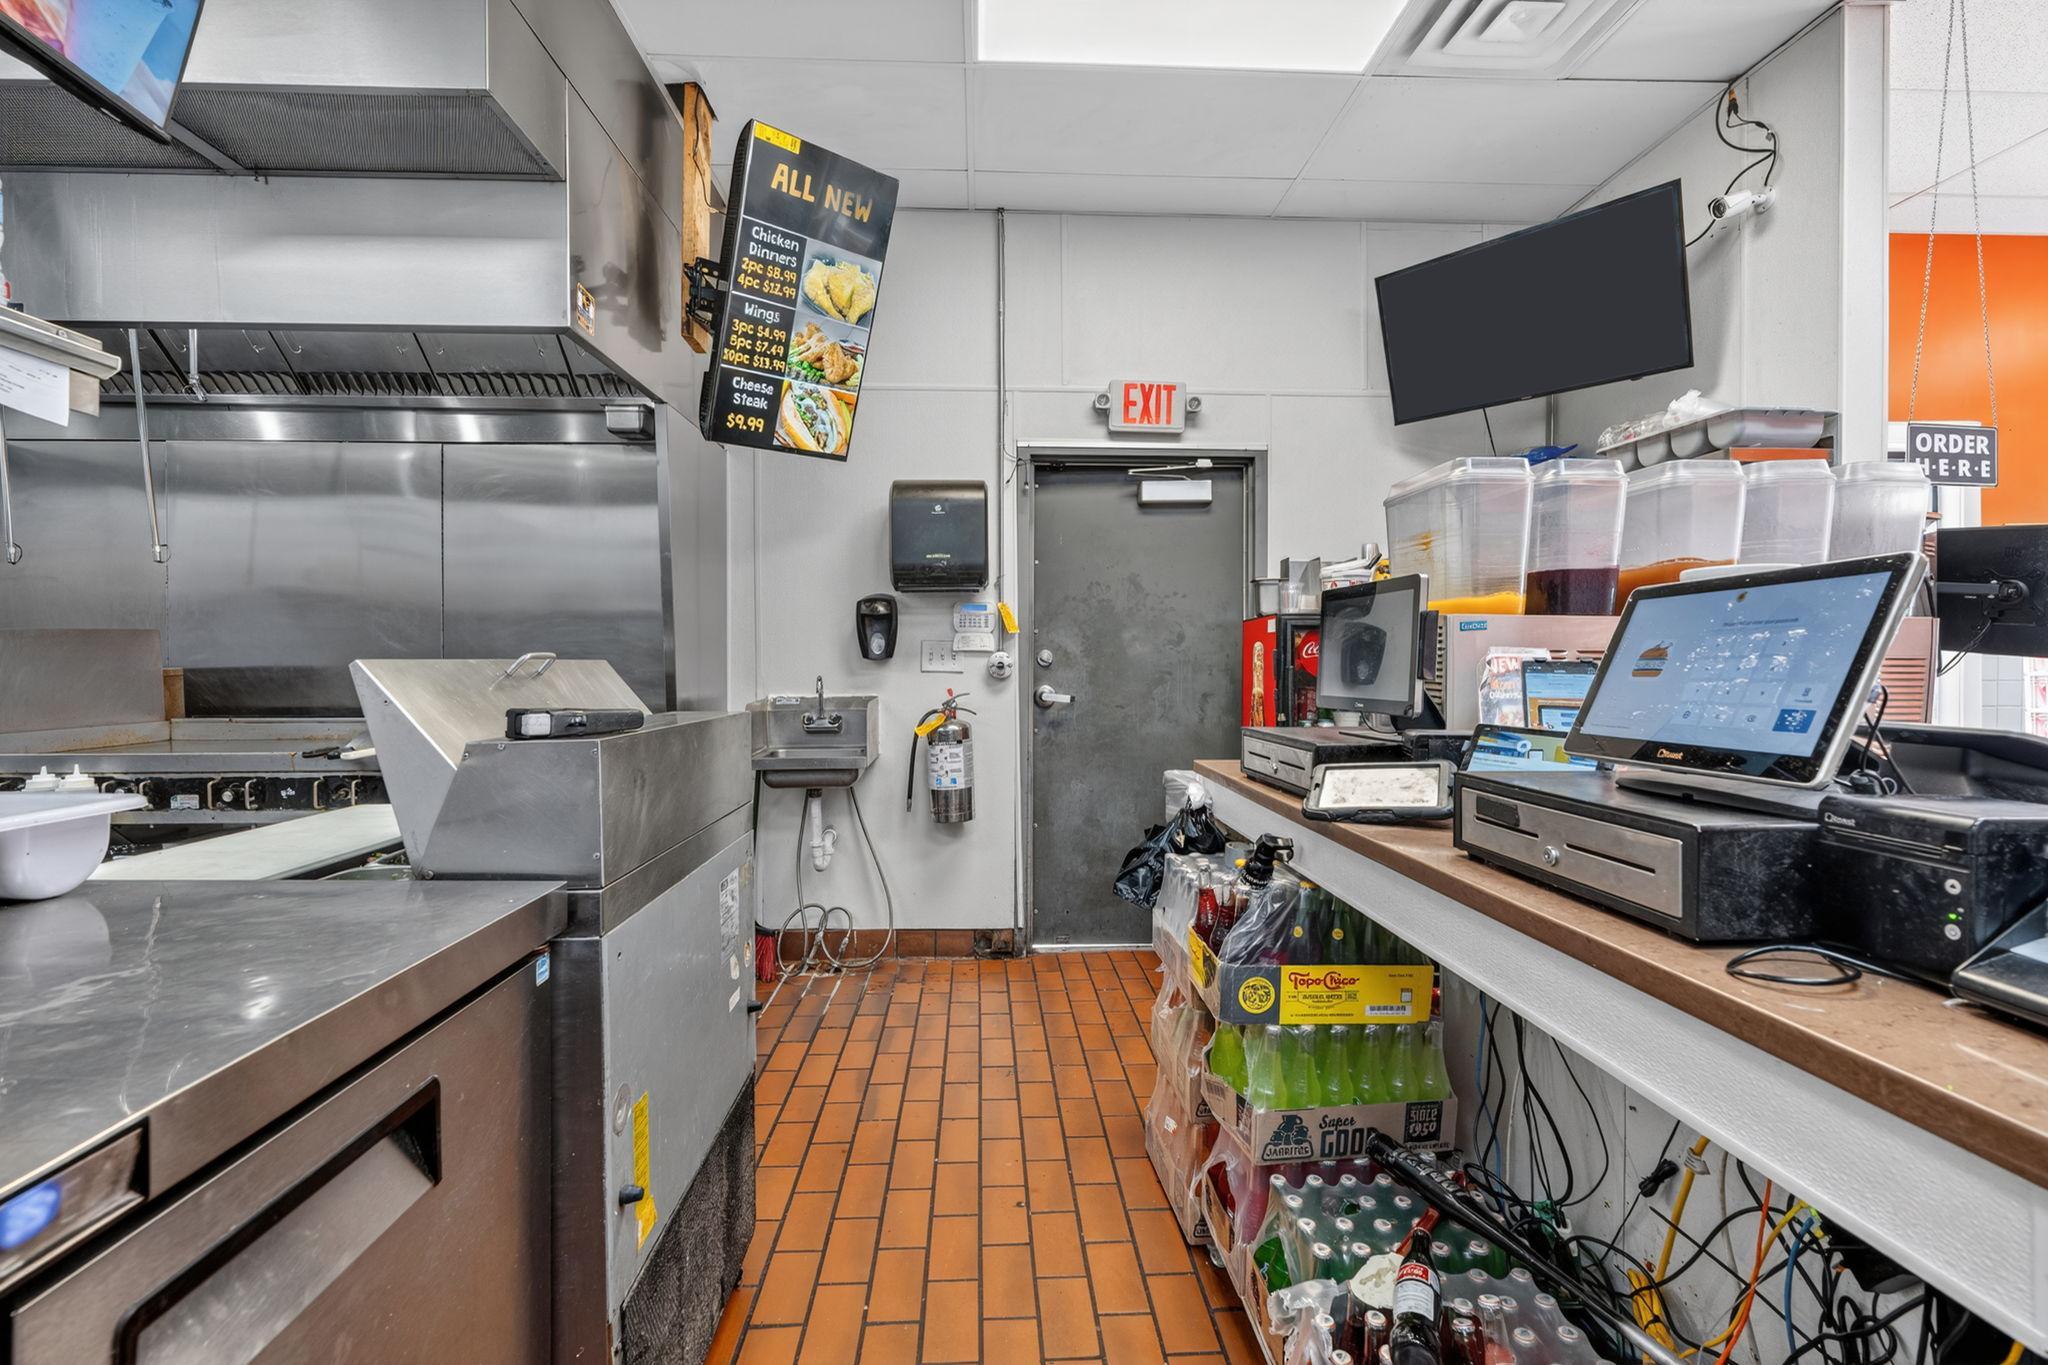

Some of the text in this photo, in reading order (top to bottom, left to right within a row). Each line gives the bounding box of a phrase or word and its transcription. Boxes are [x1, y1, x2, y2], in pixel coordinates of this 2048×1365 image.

[771, 162, 873, 223] ALL NEW
[752, 226, 799, 252] Chicken
[749, 241, 797, 268] Dinners
[741, 257, 797, 284] 2pc $8.99
[737, 273, 796, 299] 4pc $12.99
[744, 302, 780, 324] Wings
[731, 318, 786, 342] 3pc $4.99
[722, 347, 750, 365] 10pc
[754, 340, 785, 357] $7.49
[732, 376, 774, 395] Cheese
[733, 392, 768, 410] Steak
[1123, 383, 1177, 425] EXIT
[726, 412, 765, 433] $9.99
[1915, 432, 1990, 455] ORDER
[1288, 971, 1360, 990] Topo Chico
